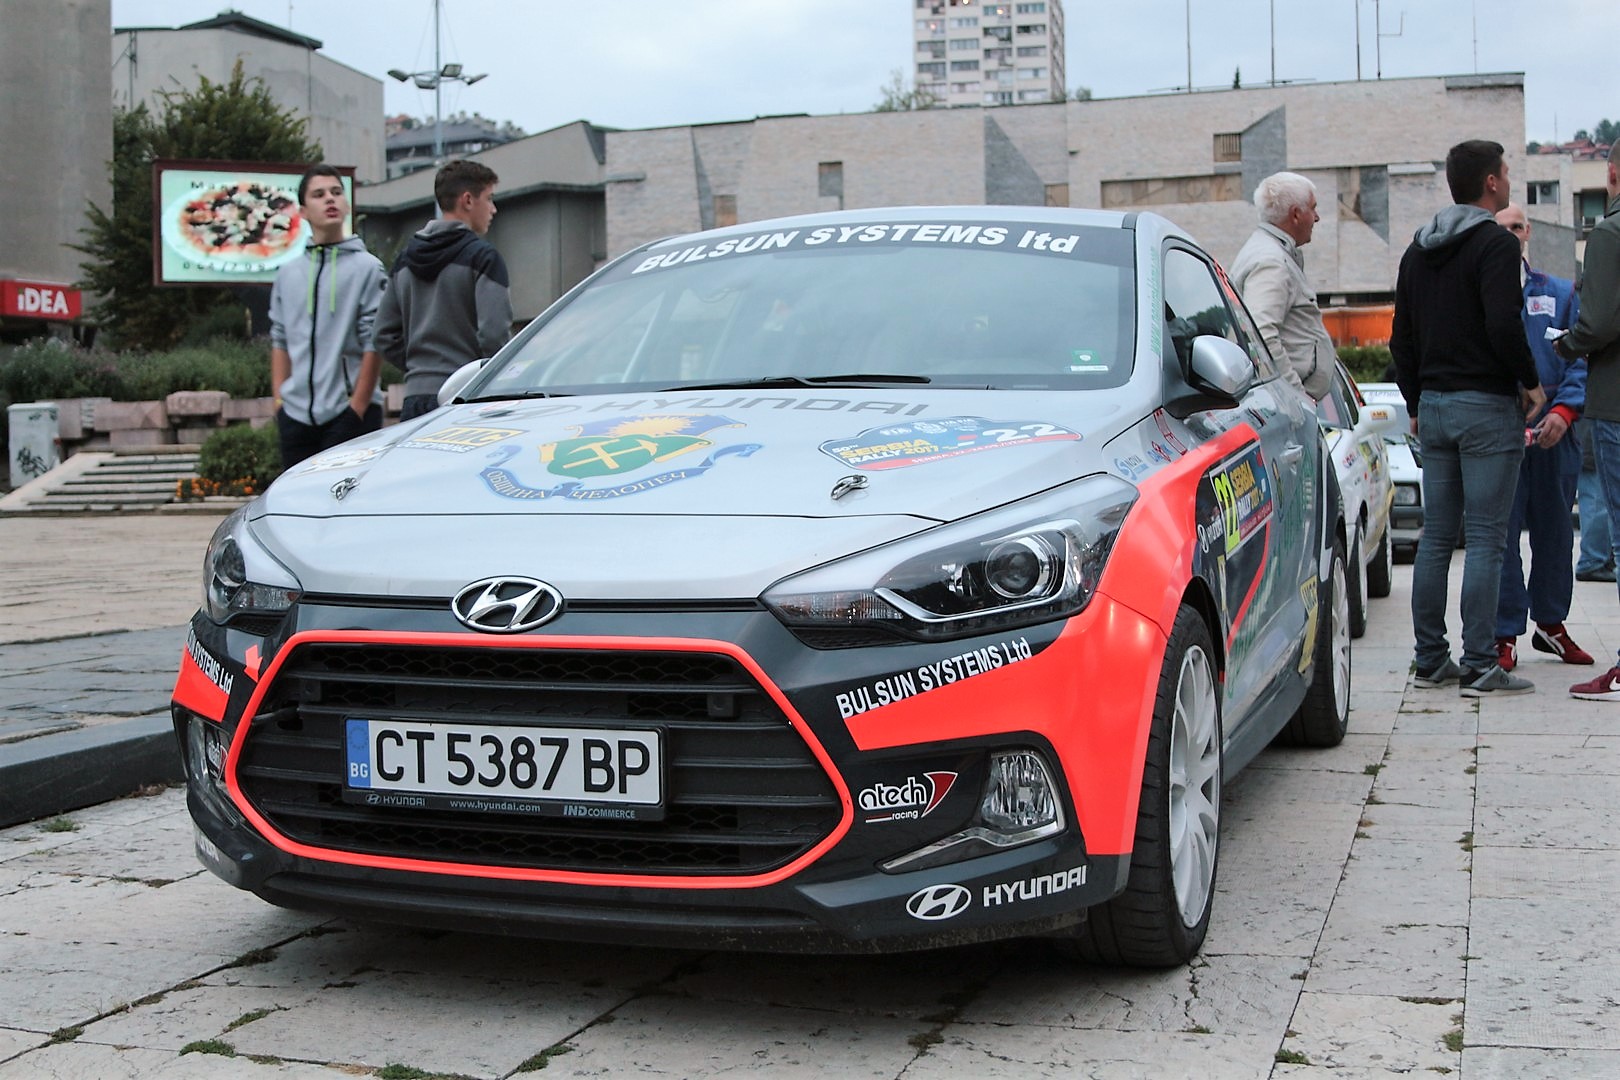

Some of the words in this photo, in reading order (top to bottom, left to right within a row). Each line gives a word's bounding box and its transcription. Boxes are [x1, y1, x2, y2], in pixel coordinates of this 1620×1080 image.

[631, 230, 800, 275] BULSUN
[804, 224, 1008, 246] SYSTEMS
[1017, 230, 1080, 254] ltd
[597, 396, 931, 417] HYUNDAI
[982, 423, 1068, 442] 22
[840, 439, 932, 460] SERBIA
[848, 450, 901, 464] RALLY
[904, 445, 939, 455] 2017
[570, 470, 687, 500] ЧЕЛОПЕЧ
[218, 667, 234, 696] Ltd
[835, 674, 918, 720] BULSUN
[918, 645, 1004, 692] SYSTEMS
[1001, 637, 1033, 665] Ltd
[350, 762, 369, 779] BG
[376, 729, 435, 784] CT
[447, 732, 569, 791] 5387
[583, 738, 651, 795] BP
[383, 795, 426, 807] HYUNDAI
[450, 799, 542, 813] www.hyundai.com
[892, 808, 919, 820] racing
[983, 865, 1088, 908] HYUNDAI
